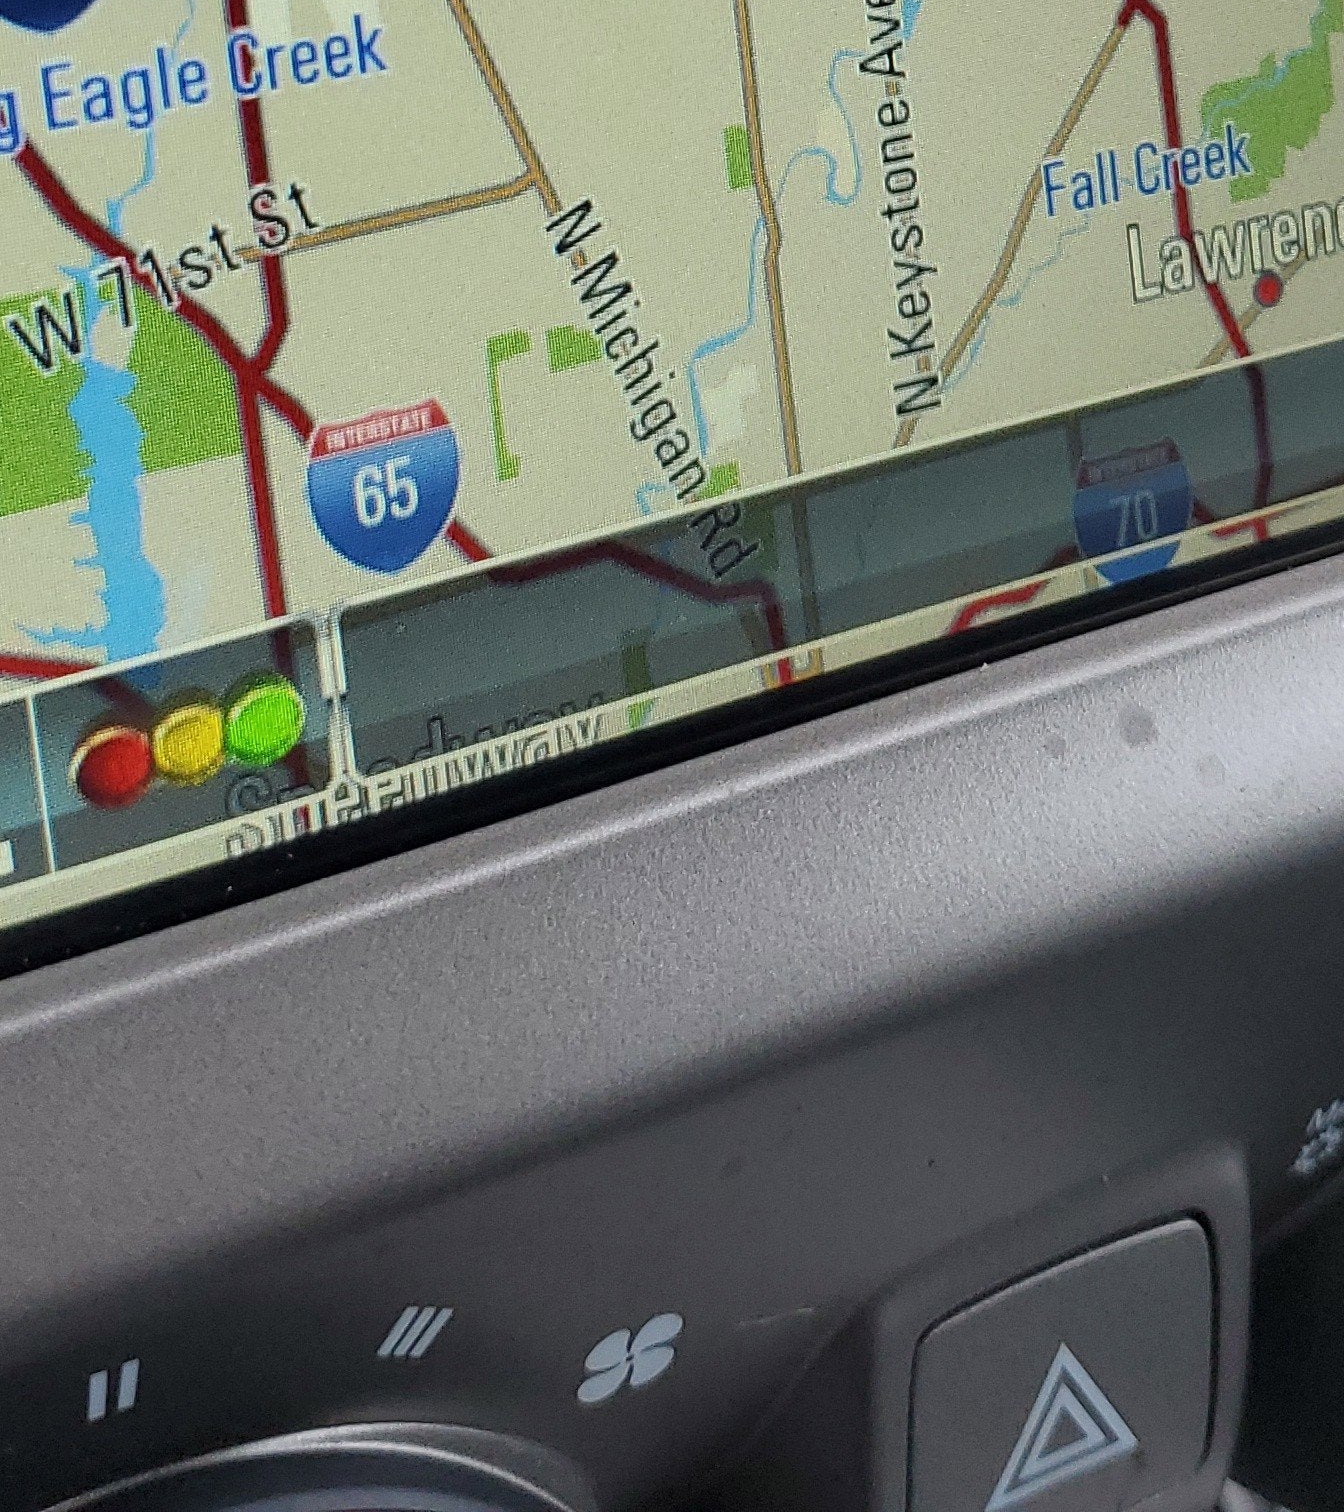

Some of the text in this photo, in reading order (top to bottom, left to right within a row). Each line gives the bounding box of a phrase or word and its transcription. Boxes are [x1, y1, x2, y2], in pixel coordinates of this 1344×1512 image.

[40, 47, 208, 133] Eagle
[227, 14, 388, 97] Creek
[1042, 122, 1254, 218] Fall Creek
[7, 181, 320, 374] W 71st St
[877, 95, 940, 368] Keystone
[544, 198, 763, 581] N Michigan Rd
[894, 369, 943, 418] N
[352, 454, 419, 529] 65
[1109, 489, 1158, 548] 70
